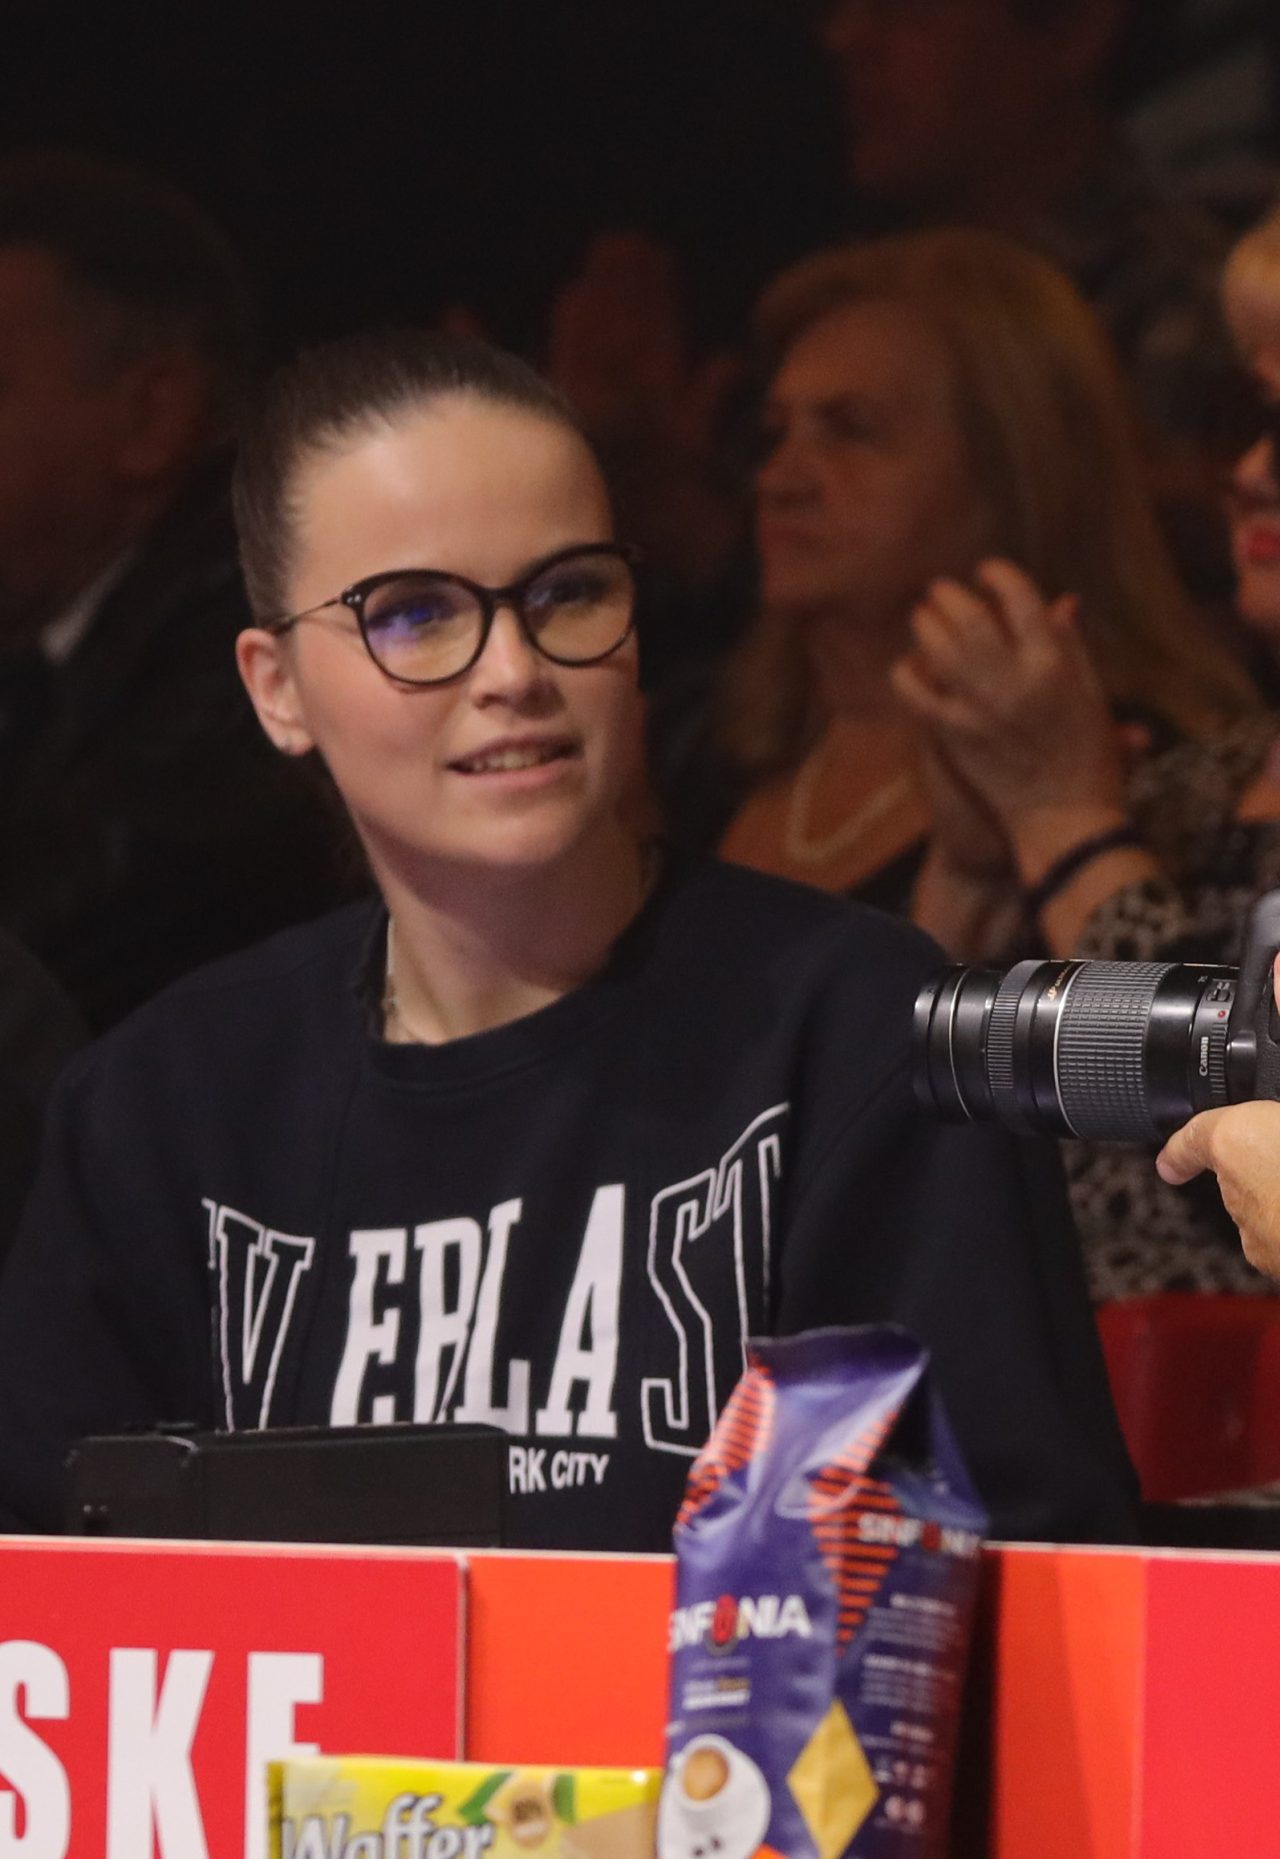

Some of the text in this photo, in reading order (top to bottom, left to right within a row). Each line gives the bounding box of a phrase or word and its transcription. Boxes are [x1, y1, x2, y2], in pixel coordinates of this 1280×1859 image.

[1199, 1036, 1209, 1077] Canon
[202, 1102, 790, 1456] VERLAST
[508, 1445, 610, 1494] RK CITY
